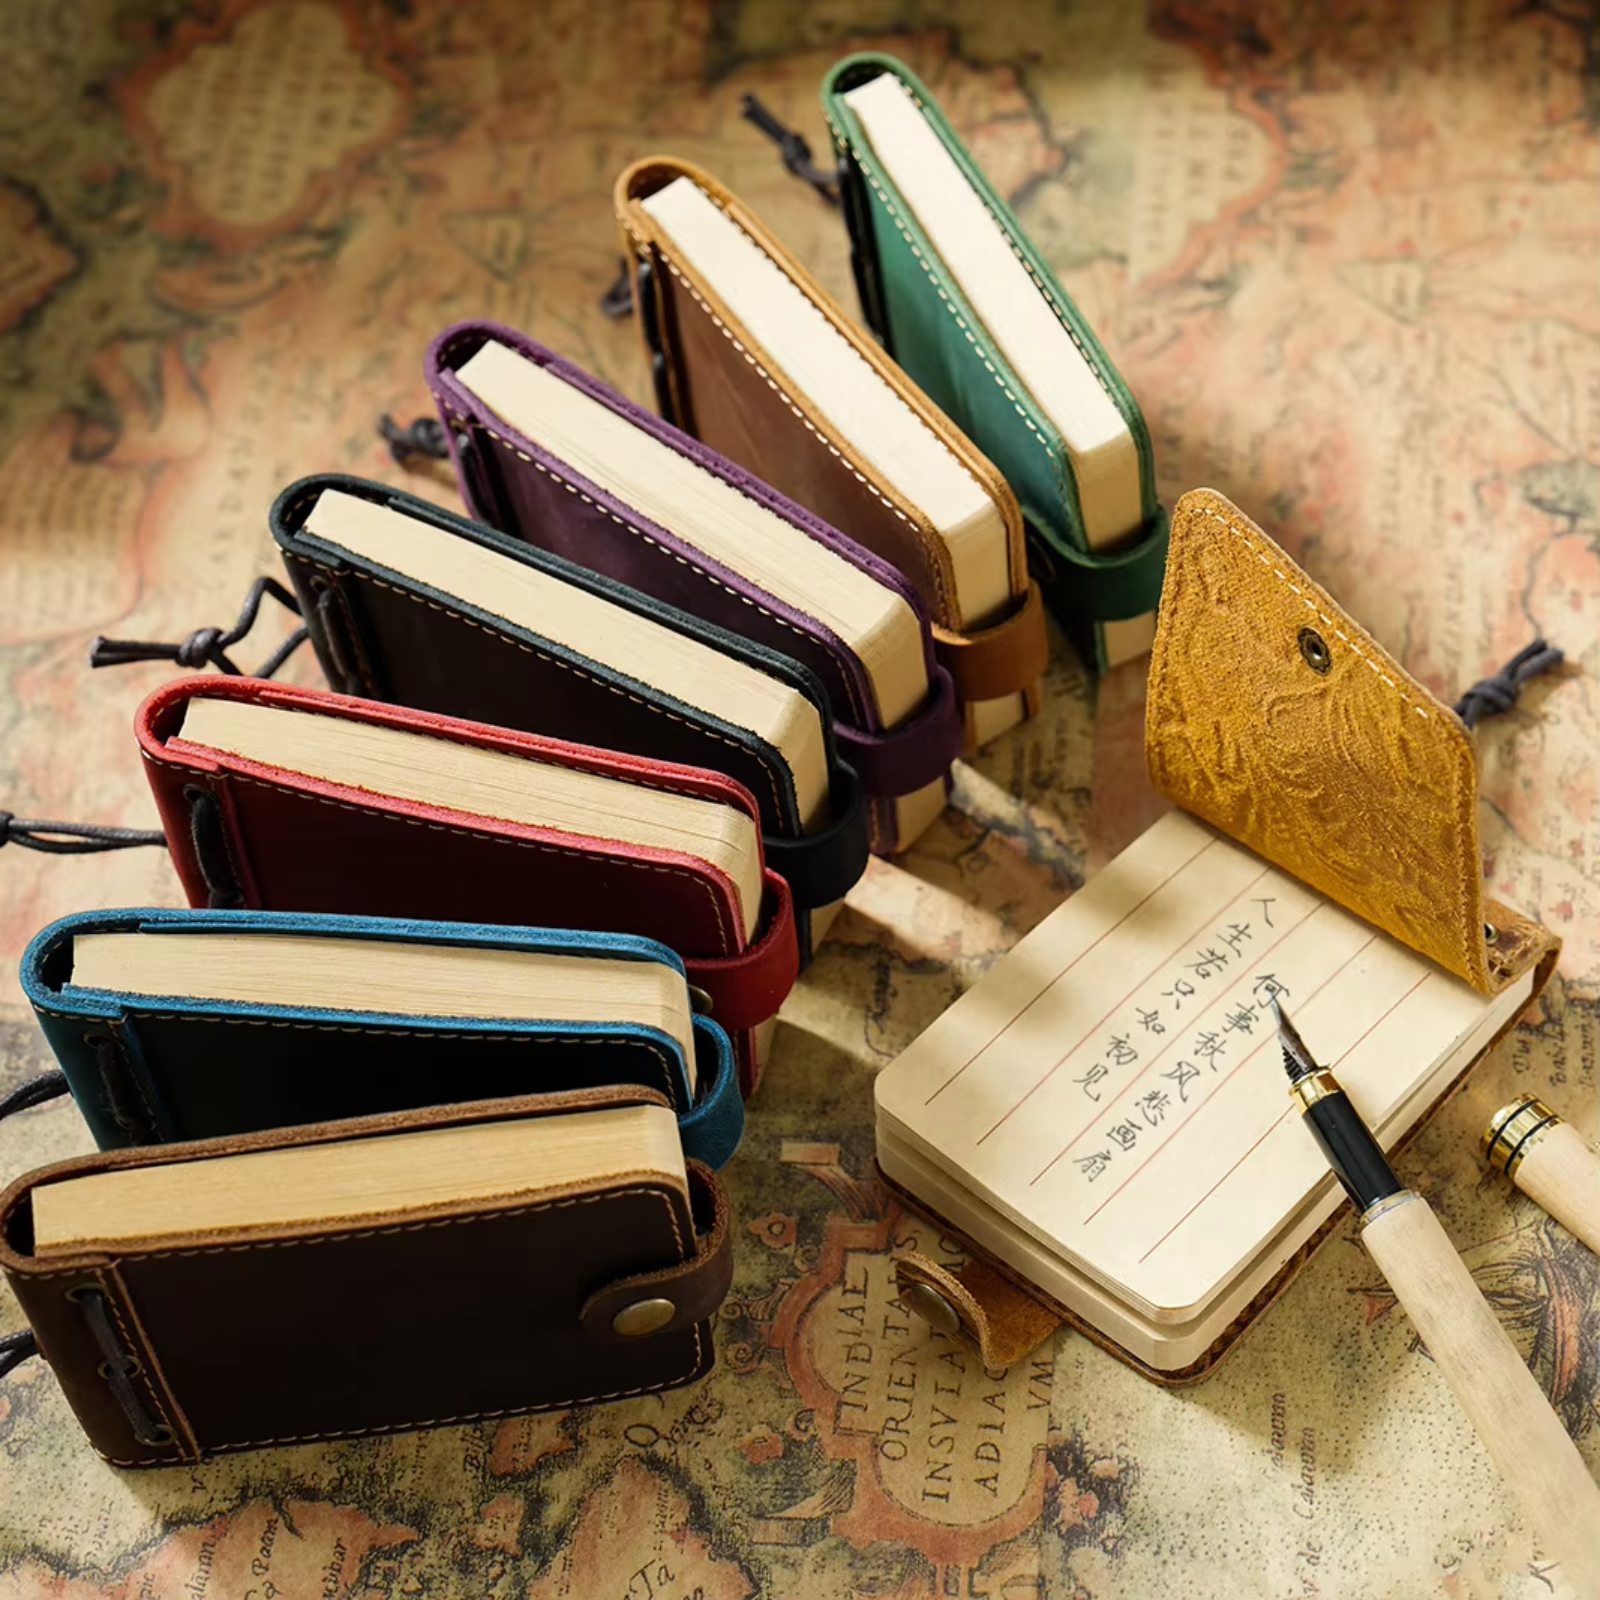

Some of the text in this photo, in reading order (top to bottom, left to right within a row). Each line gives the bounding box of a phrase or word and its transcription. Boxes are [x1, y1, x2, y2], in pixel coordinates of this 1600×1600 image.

[1072, 897, 1277, 1103] 人生若只如初见
[1072, 972, 1291, 1183] 何事秋风悲画扇
[838, 1267, 872, 1413] INDIAE
